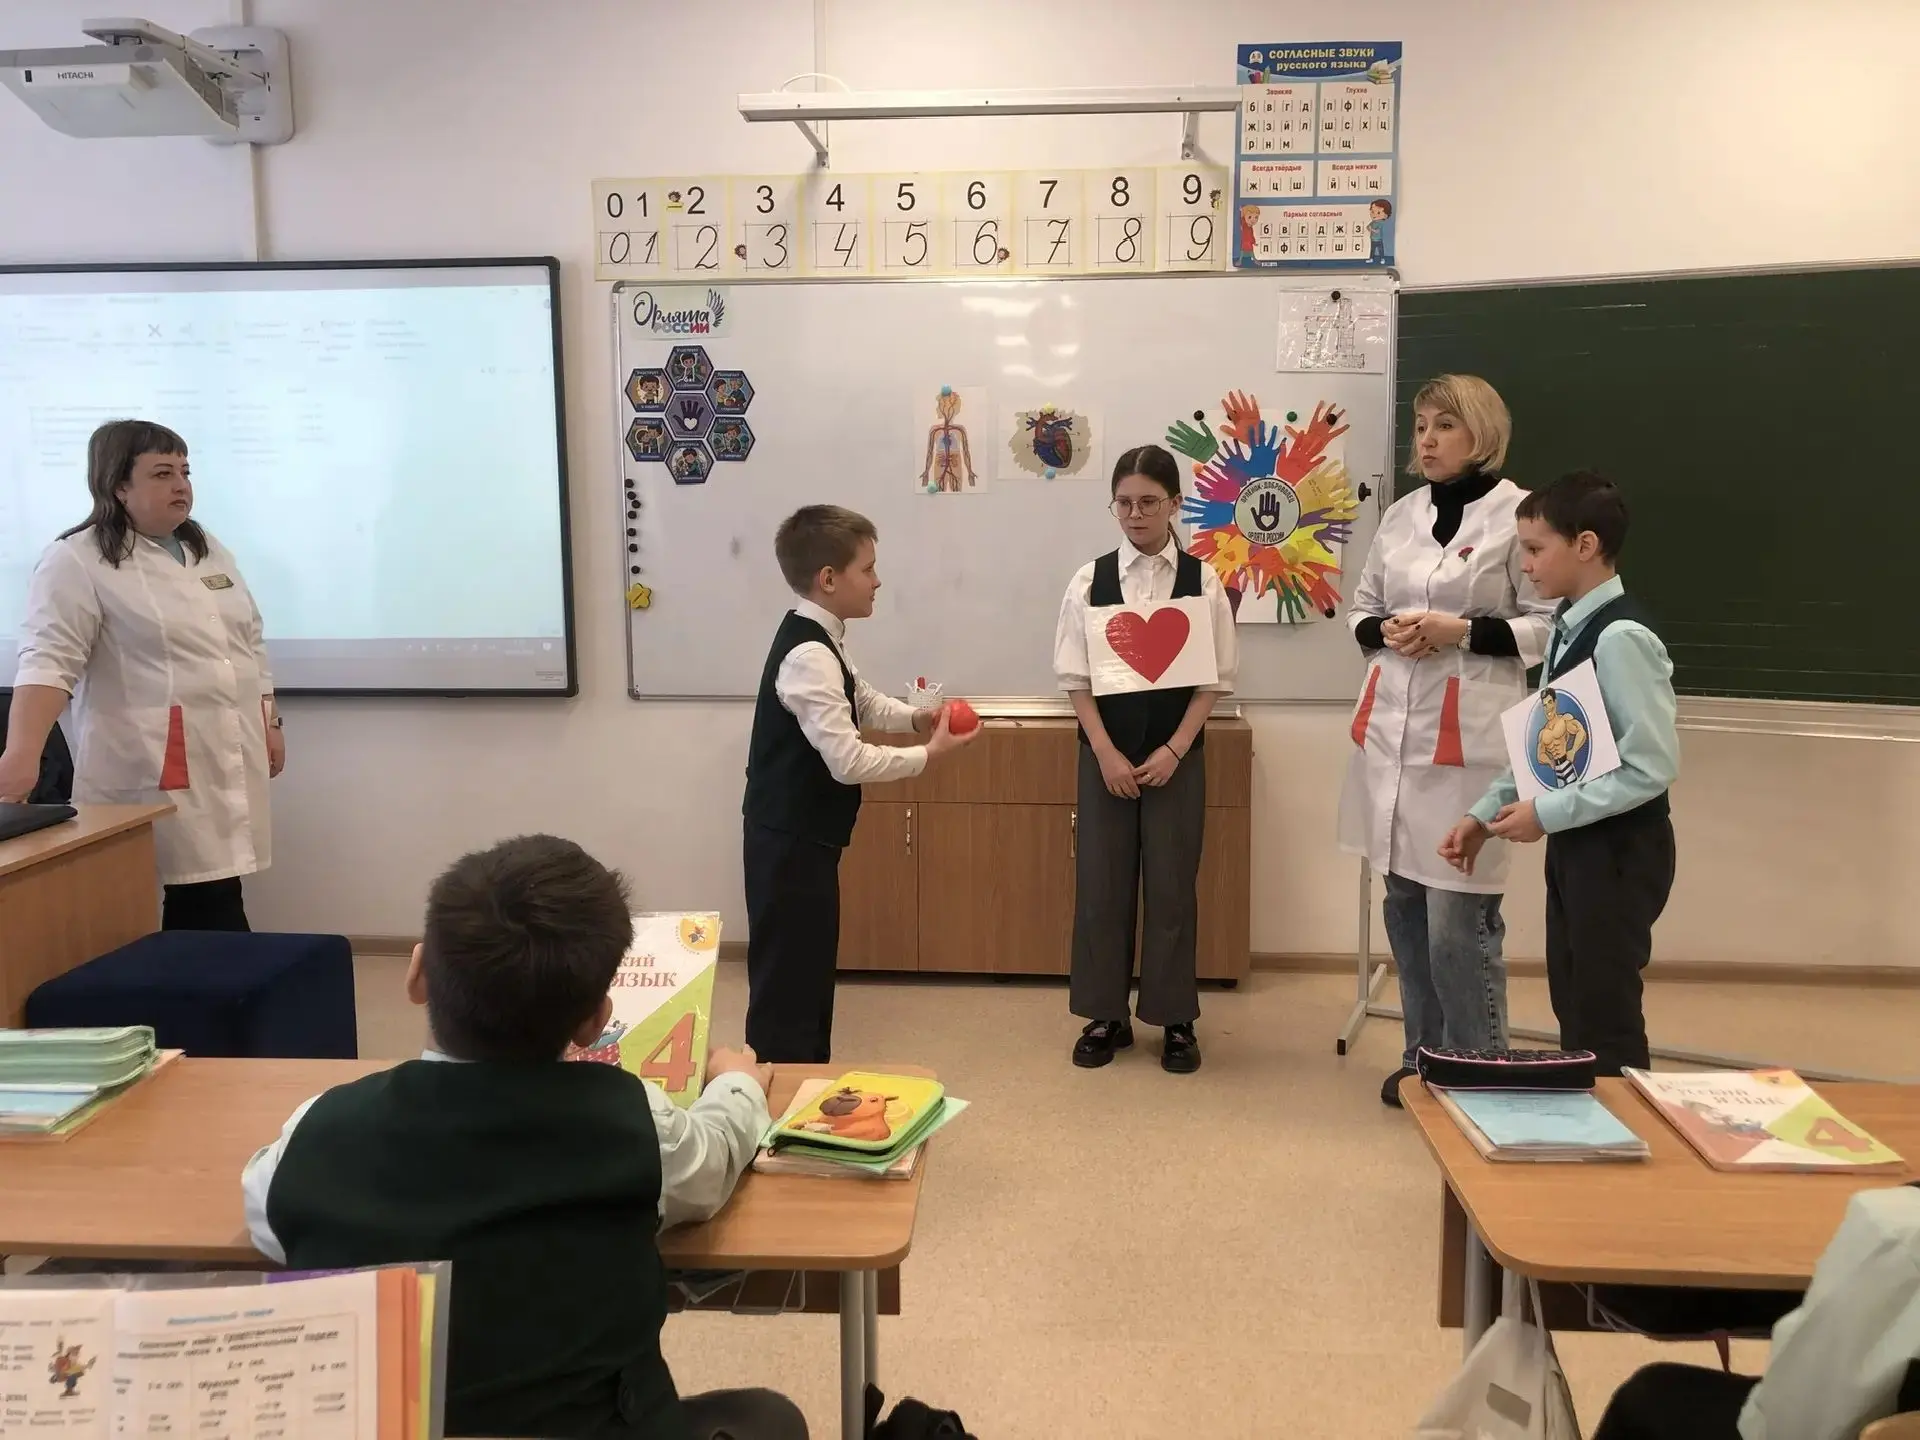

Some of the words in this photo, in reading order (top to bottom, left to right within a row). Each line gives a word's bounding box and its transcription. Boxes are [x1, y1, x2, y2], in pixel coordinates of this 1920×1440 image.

[1268, 49, 1336, 59] СОГЛАСНЫЕ
[1338, 48, 1375, 58] ЗВУКИ
[1276, 61, 1328, 72] русского
[1330, 60, 1367, 69] языка
[57, 71, 94, 80] HITACHI
[607, 192, 623, 218] 0
[637, 192, 647, 217] 1
[687, 186, 705, 214] 2
[756, 185, 775, 213] 3
[826, 183, 845, 212] 4
[897, 183, 916, 211] 5
[967, 181, 986, 210] 6
[1039, 180, 1058, 208] 7
[1111, 176, 1130, 207] 8
[1183, 174, 1202, 204] 9
[609, 231, 630, 264] 0
[645, 231, 658, 263] 1
[694, 225, 719, 269] 2
[763, 224, 787, 268] 3
[834, 223, 857, 267] 4
[902, 222, 928, 266] 5
[973, 220, 998, 264] 6
[1047, 219, 1070, 263] 7
[1115, 217, 1141, 262] 8
[1187, 215, 1212, 261] 9
[633, 291, 709, 329] Орлята
[653, 322, 710, 333] РОССИИ
[640, 1012, 697, 1093] 4
[1804, 1116, 1876, 1153] 4
